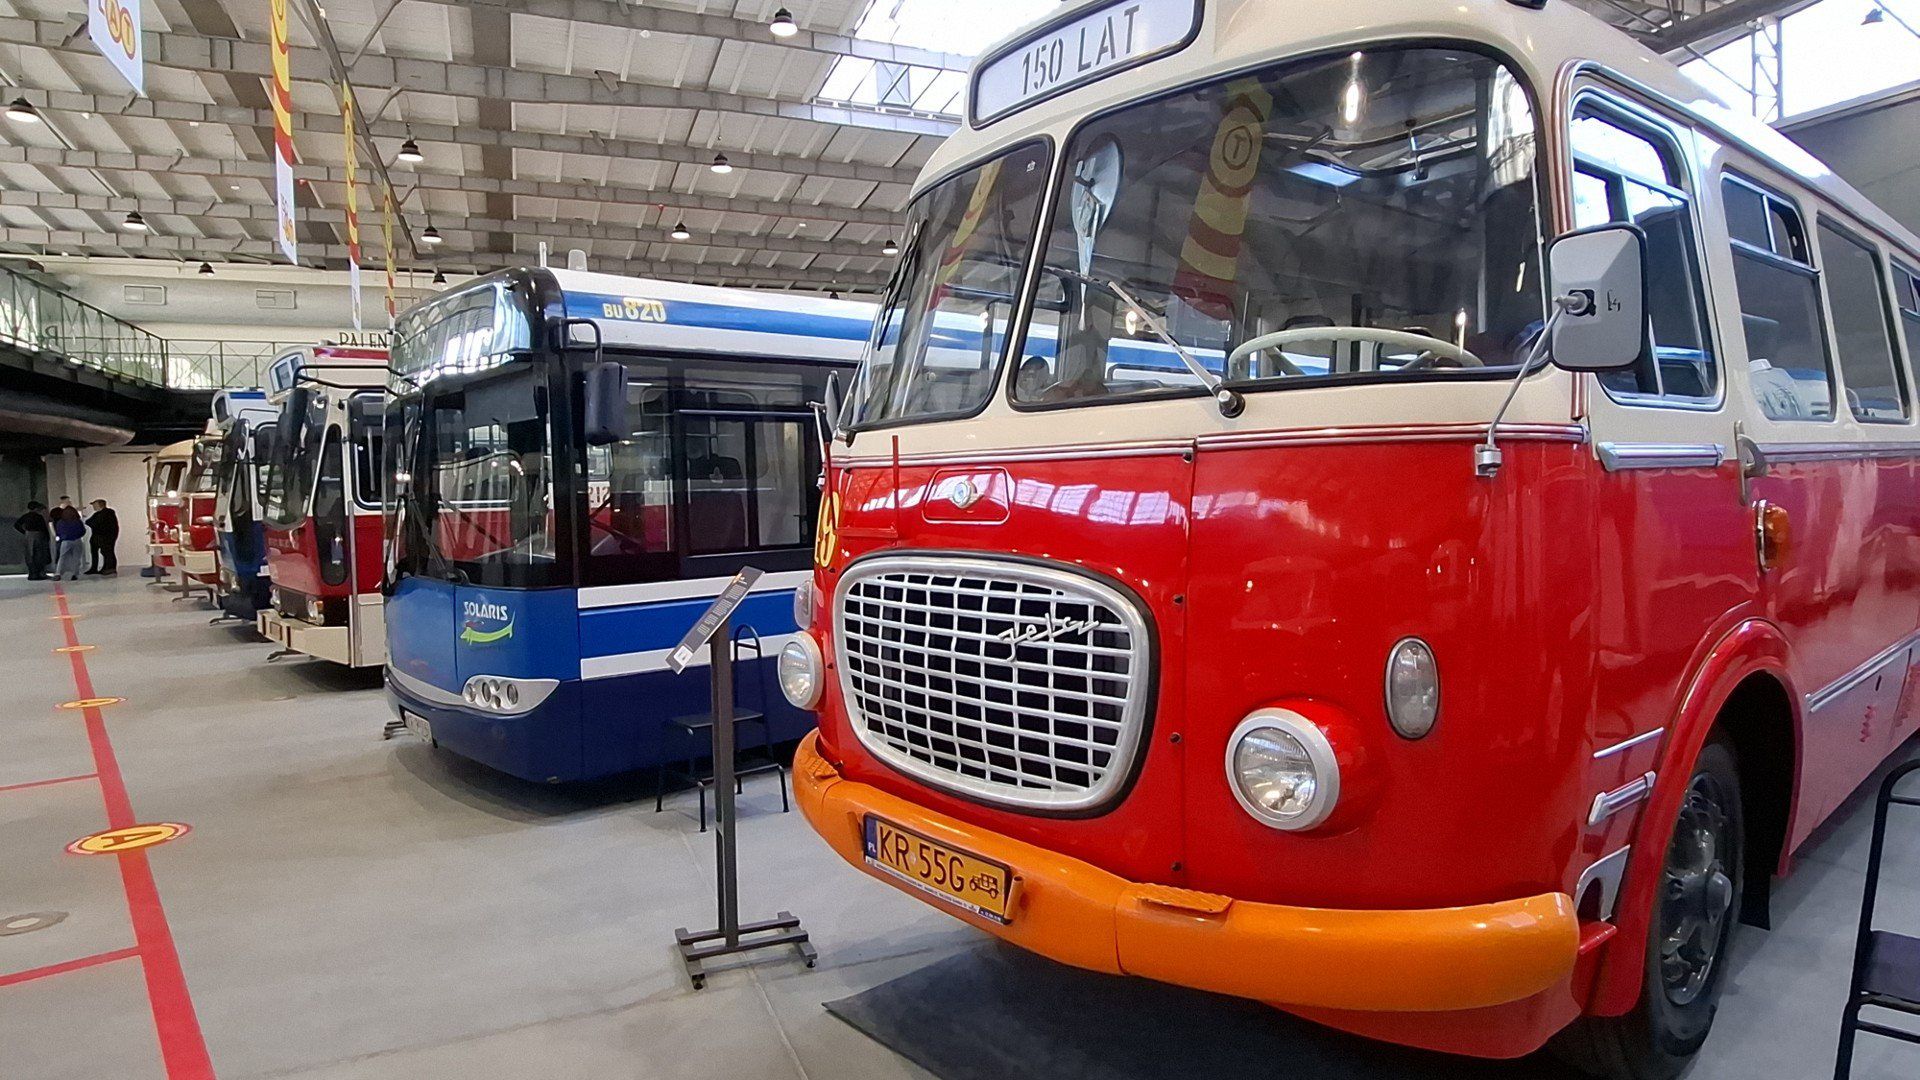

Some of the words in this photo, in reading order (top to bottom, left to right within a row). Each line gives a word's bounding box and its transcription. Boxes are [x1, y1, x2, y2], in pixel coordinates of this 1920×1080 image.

[1022, 38, 1064, 95] 150
[1077, 4, 1140, 73] LAT
[602, 303, 623, 319] BU
[623, 297, 667, 322] 820
[463, 601, 508, 621] SOLARIS
[868, 842, 877, 853] PL
[879, 826, 910, 872] KR
[919, 843, 965, 892] 55G
